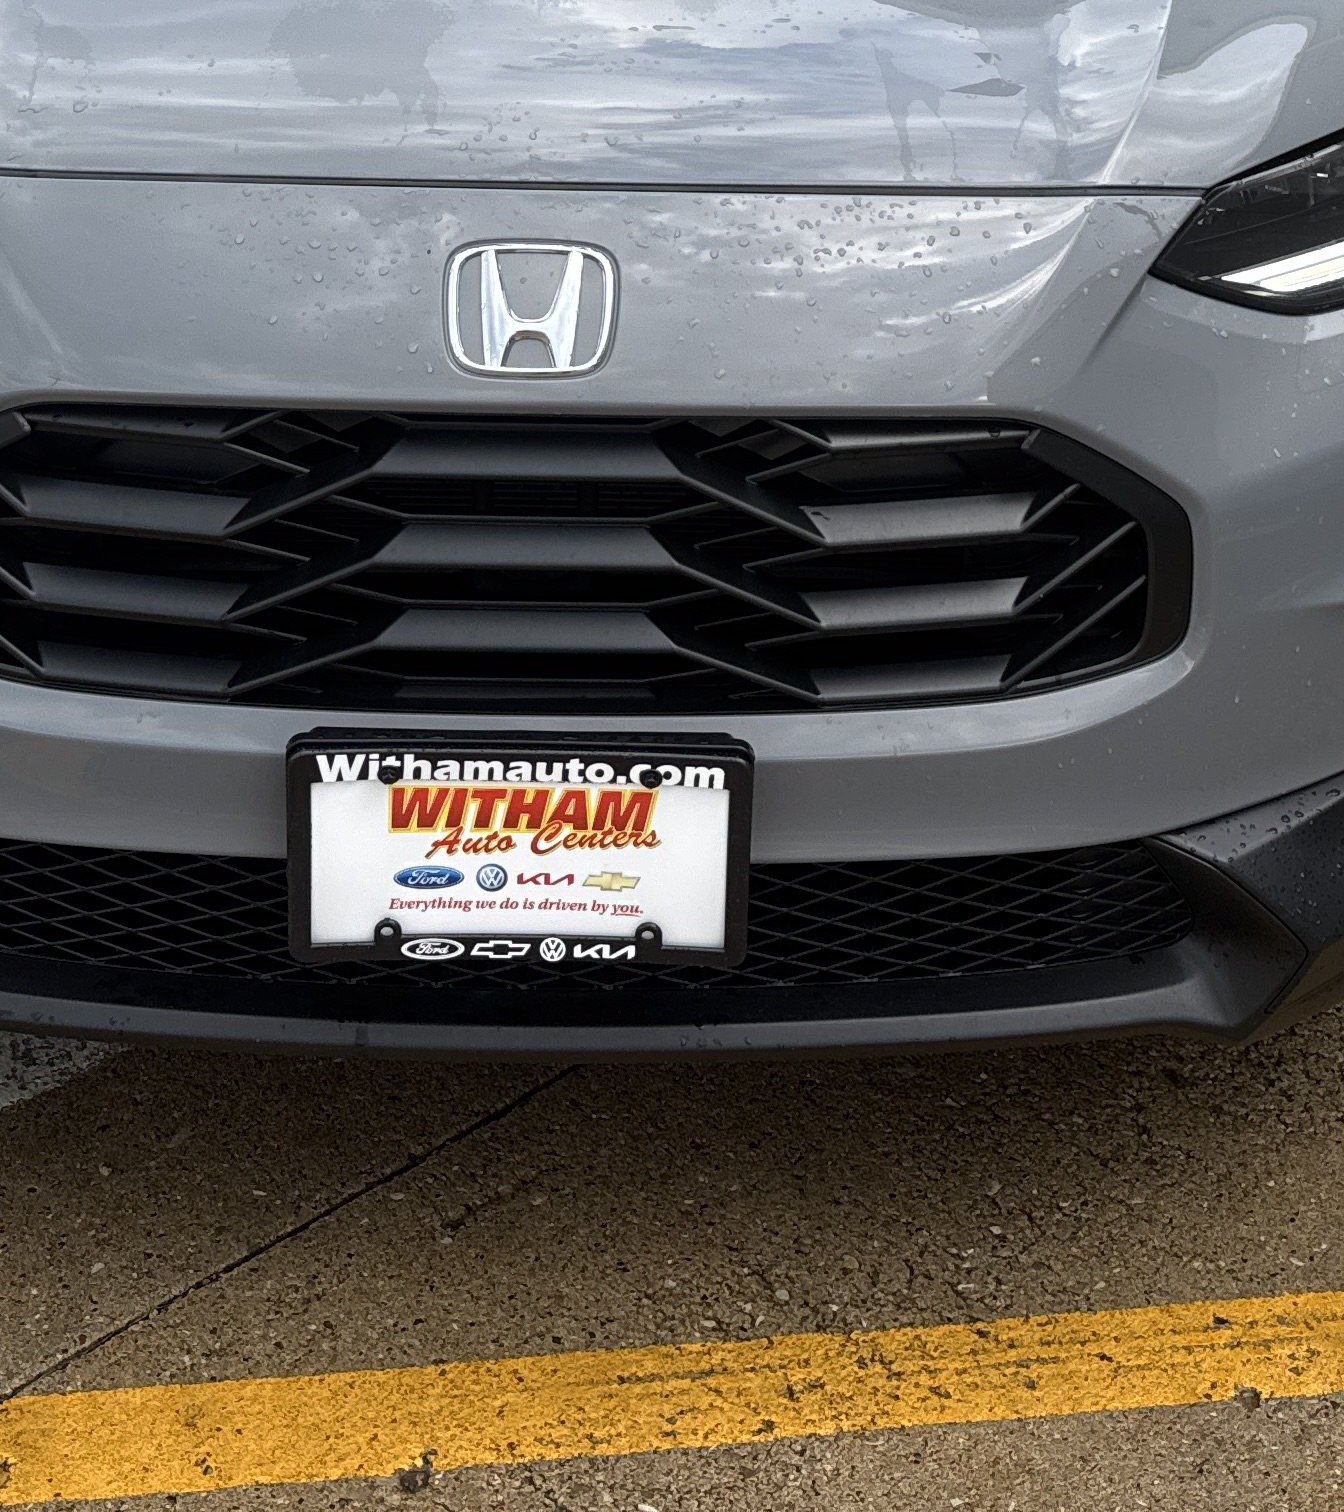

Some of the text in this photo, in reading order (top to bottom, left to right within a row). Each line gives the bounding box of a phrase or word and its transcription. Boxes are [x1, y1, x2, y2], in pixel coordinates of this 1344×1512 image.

[388, 784, 658, 834] WITHAM
[424, 819, 662, 859] Auto Centers
[407, 869, 450, 886] Ford
[389, 897, 645, 916] Everything we do is driven by you.
[415, 941, 450, 956] Ford
